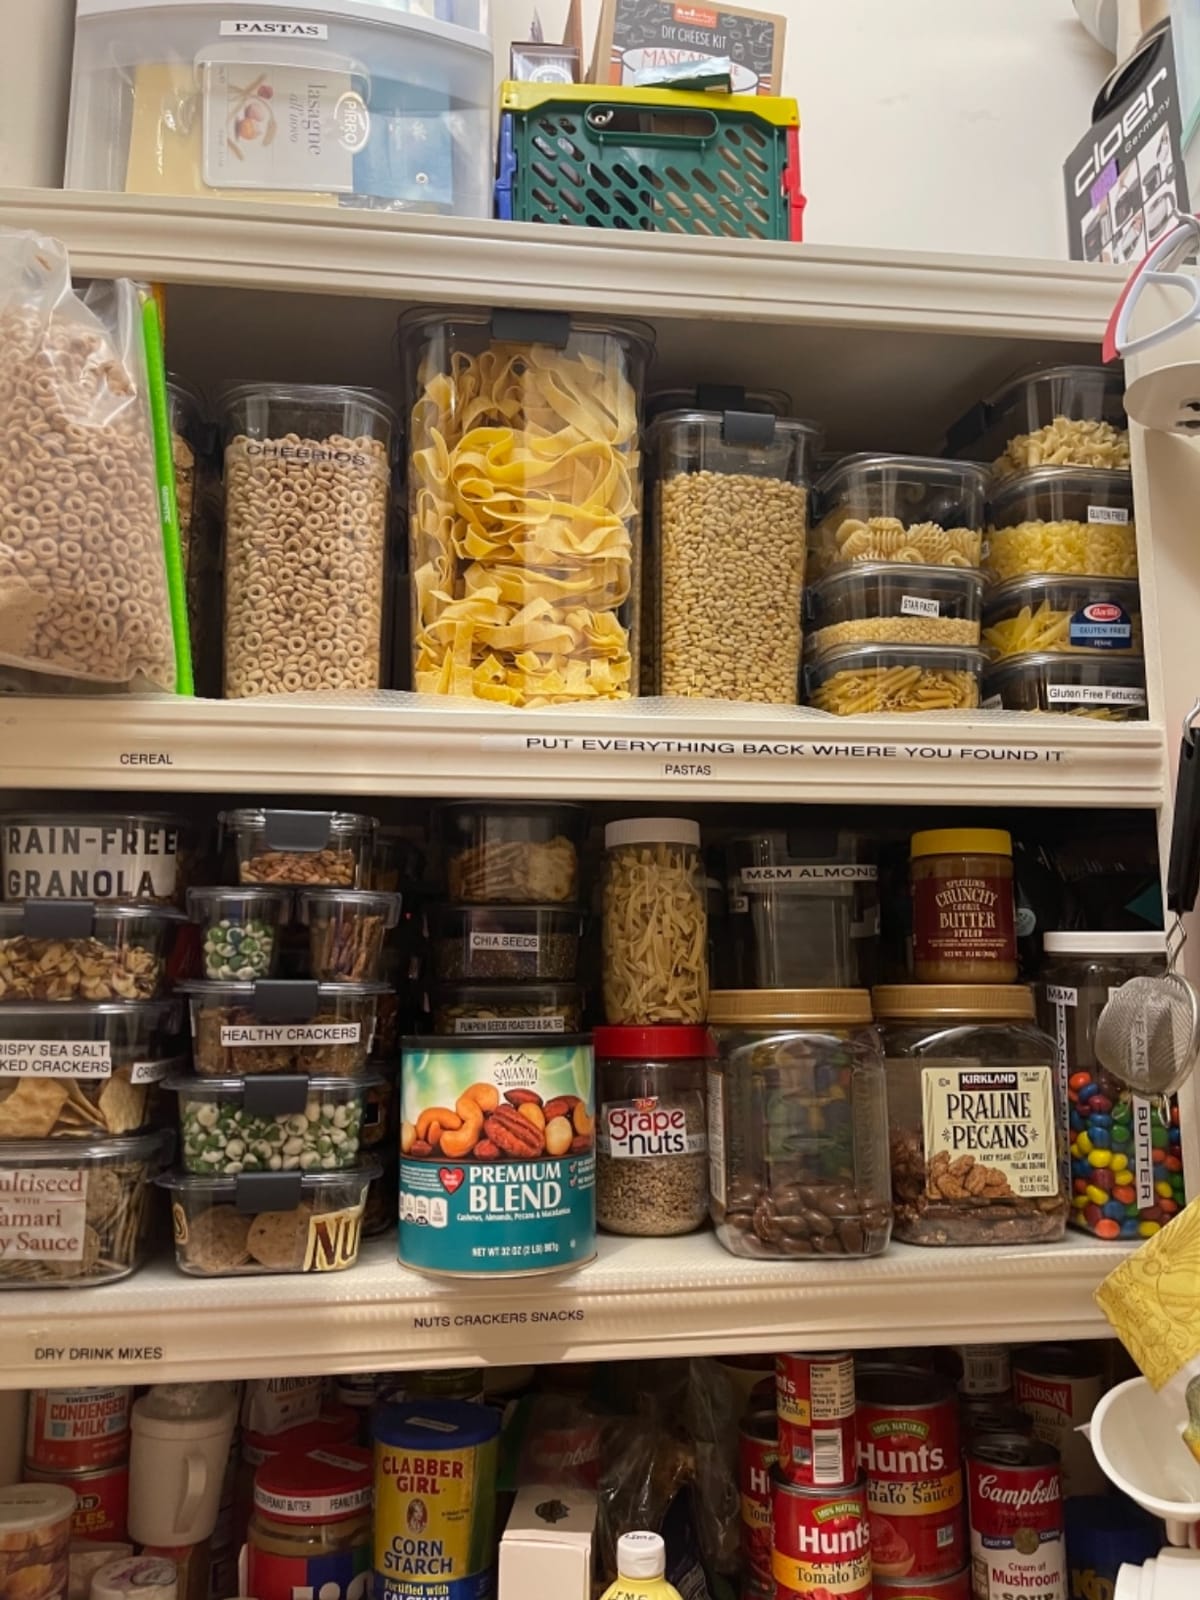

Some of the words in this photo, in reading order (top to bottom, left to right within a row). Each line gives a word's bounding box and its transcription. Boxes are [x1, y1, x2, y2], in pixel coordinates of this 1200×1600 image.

[234, 23, 319, 35] PASTAS
[661, 25, 676, 40] DIY
[678, 28, 710, 47] CHEESE
[712, 33, 727, 49] KIT
[301, 83, 327, 156] lasagne
[1124, 96, 1171, 154] Germany
[1075, 67, 1167, 197] cloer
[1089, 507, 1108, 520] GLUTEN
[1109, 508, 1127, 521] FREE
[903, 597, 919, 611] STAR
[920, 599, 938, 614] PASTA
[1079, 626, 1106, 635] GLUTEN
[1109, 626, 1127, 635] FREE
[1050, 688, 1081, 698] Gluten
[1083, 688, 1103, 698] Free
[526, 737, 575, 749] PUT
[582, 739, 735, 754] EVERYTHING
[742, 743, 805, 755] BACK
[811, 744, 897, 757] WHERE
[904, 747, 952, 759] YOU
[960, 748, 1039, 761] FOUND
[1045, 750, 1064, 762] IT
[120, 753, 173, 766] CEREAL
[664, 764, 712, 776] PASTAS
[746, 869, 792, 879] M&M
[7, 870, 156, 898] GRANOLA
[935, 887, 999, 908] CRUNCHY
[939, 911, 996, 928] BUTTER
[472, 936, 499, 947] CHIA
[502, 936, 537, 948] SEEDS
[1049, 988, 1075, 1001] M&M
[221, 1027, 283, 1041] HEALTHY
[288, 1026, 357, 1040] CRACKERS
[40, 1045, 68, 1056] SEA
[72, 1045, 108, 1057] SALT
[32, 1060, 110, 1073] CRACKERS
[493, 1066, 538, 1081] SAVANNA
[961, 1073, 1016, 1085] KIRKLAND
[946, 1092, 1032, 1123] PRALINE
[609, 1108, 685, 1141] grape
[618, 1130, 685, 1155] -nuts
[952, 1124, 1029, 1150] PECANS
[1137, 1106, 1151, 1200] BUTTER
[469, 1162, 562, 1183] PREMIUM
[469, 1181, 562, 1213] BLEND
[17, 1232, 79, 1251] Sauce
[472, 1247, 486, 1257] NET
[488, 1247, 499, 1256] WT
[501, 1246, 510, 1255] 32
[413, 1316, 450, 1328] NUTS
[454, 1312, 527, 1327] CRACKERS
[531, 1310, 585, 1322] SNACKS
[34, 1347, 65, 1360] DRY
[69, 1348, 114, 1360] DRINK
[118, 1347, 163, 1360] MIXES
[65, 1392, 116, 1403] SWEETENED
[1019, 1381, 1068, 1409] LINDSAY
[50, 1396, 125, 1420] CONDENSED
[73, 1419, 107, 1437] MILK
[892, 1422, 926, 1435] NATURAL
[382, 1456, 464, 1479] CLABBER
[396, 1476, 440, 1494] GIRL
[912, 1485, 954, 1504] Sauce
[391, 1536, 444, 1557] CORN
[383, 1552, 453, 1575] STARCH
[1007, 1562, 1036, 1572] Cream
[1038, 1562, 1046, 1571] of
[797, 1566, 850, 1585] Tomato
[992, 1568, 1060, 1587] Mushroom
[384, 1579, 423, 1596] Fortified
[425, 1581, 449, 1594] with
